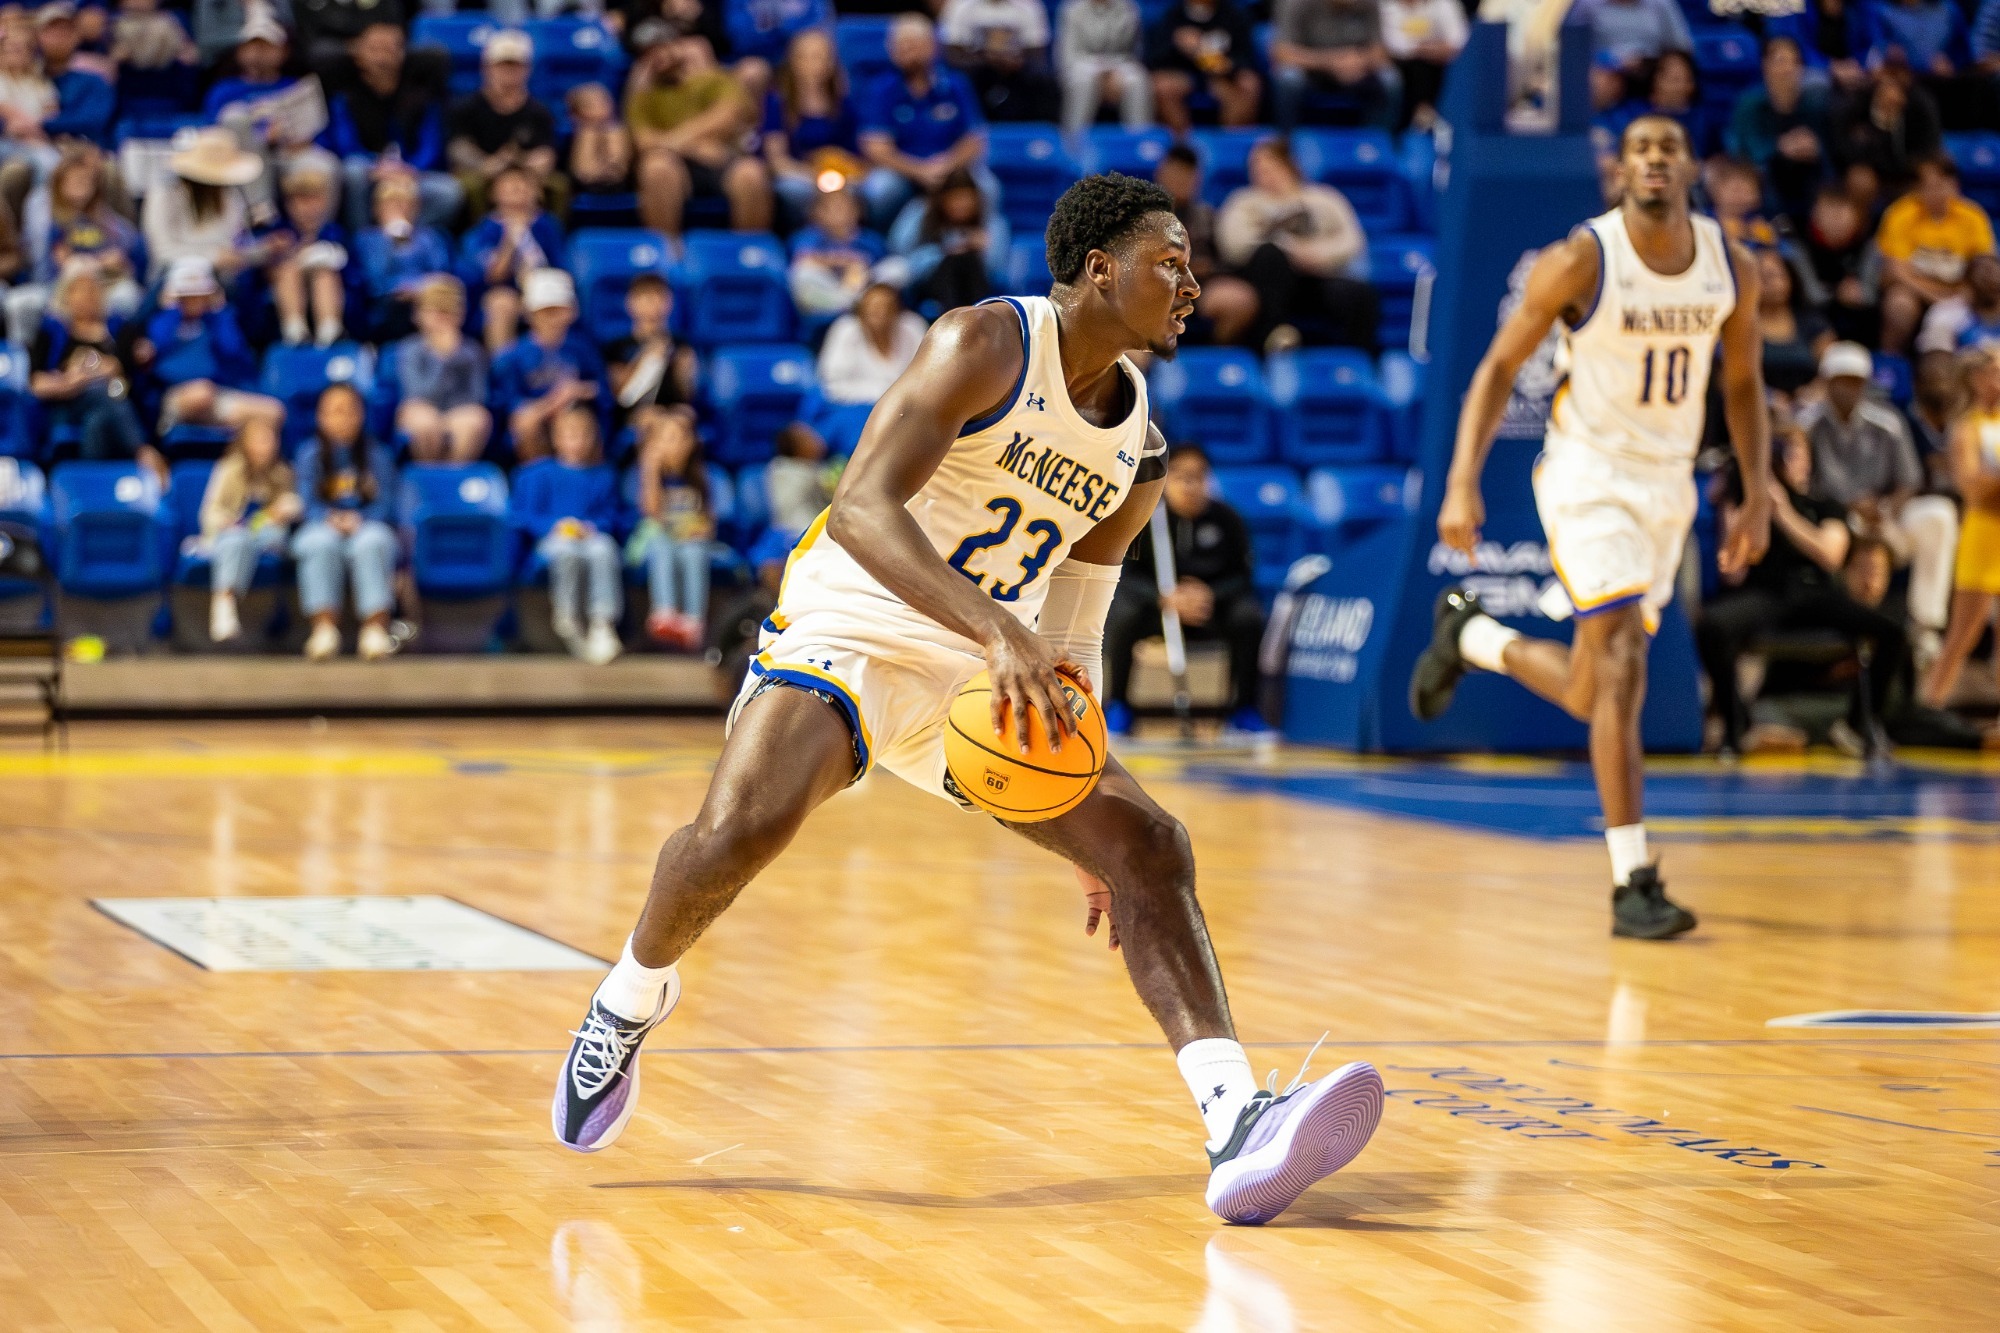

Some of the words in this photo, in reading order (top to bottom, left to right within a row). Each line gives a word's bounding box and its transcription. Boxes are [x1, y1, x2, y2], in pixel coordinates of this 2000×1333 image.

[1638, 345, 1690, 404] 10
[995, 431, 1120, 523] McNEESE
[947, 495, 1064, 602] 23
[986, 777, 1004, 790] 60
[1384, 1088, 1612, 1141] COURT
[1384, 1064, 1546, 1093] JOE
[1504, 1095, 1827, 1169] DUMARS
